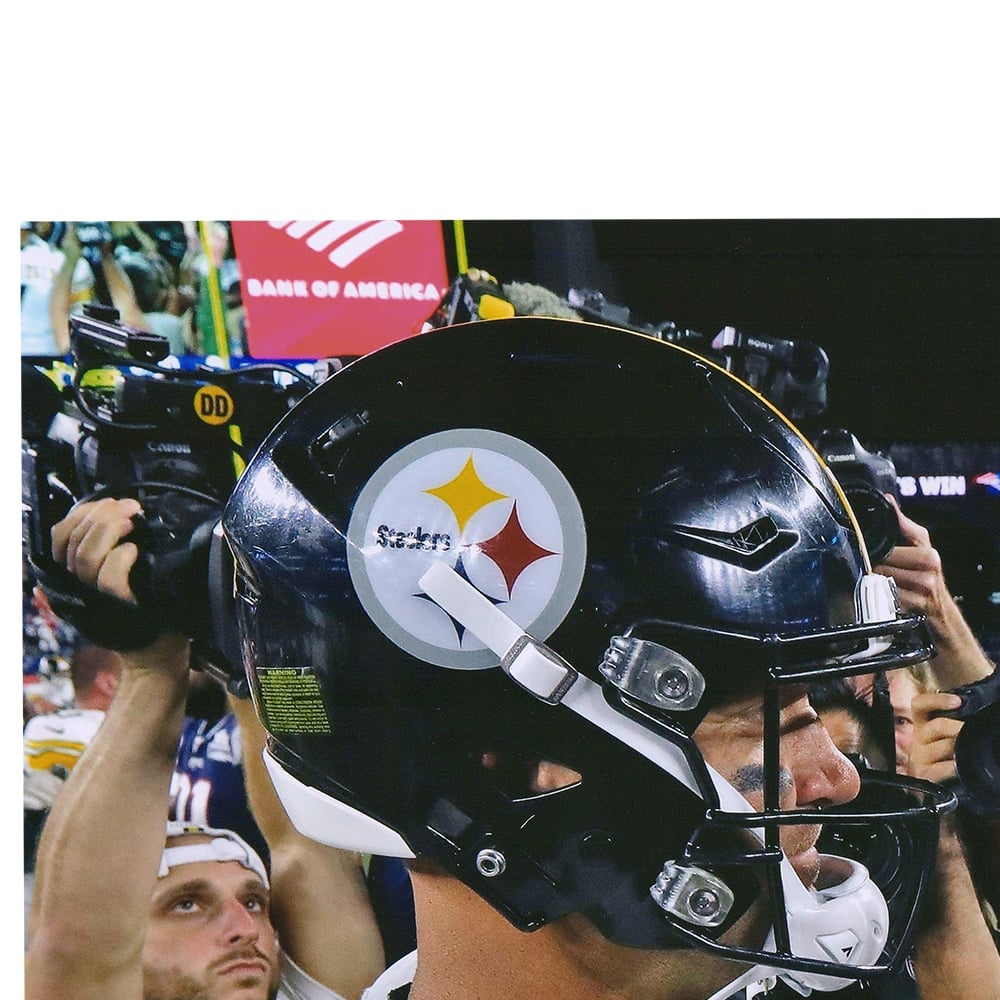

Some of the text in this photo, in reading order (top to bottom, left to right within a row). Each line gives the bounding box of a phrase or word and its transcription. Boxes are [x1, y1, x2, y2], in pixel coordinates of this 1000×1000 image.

[247, 279, 441, 300] BANK OF AMERICA
[201, 393, 228, 417] DD
[827, 454, 856, 462] Canon
[920, 476, 966, 496] WIN
